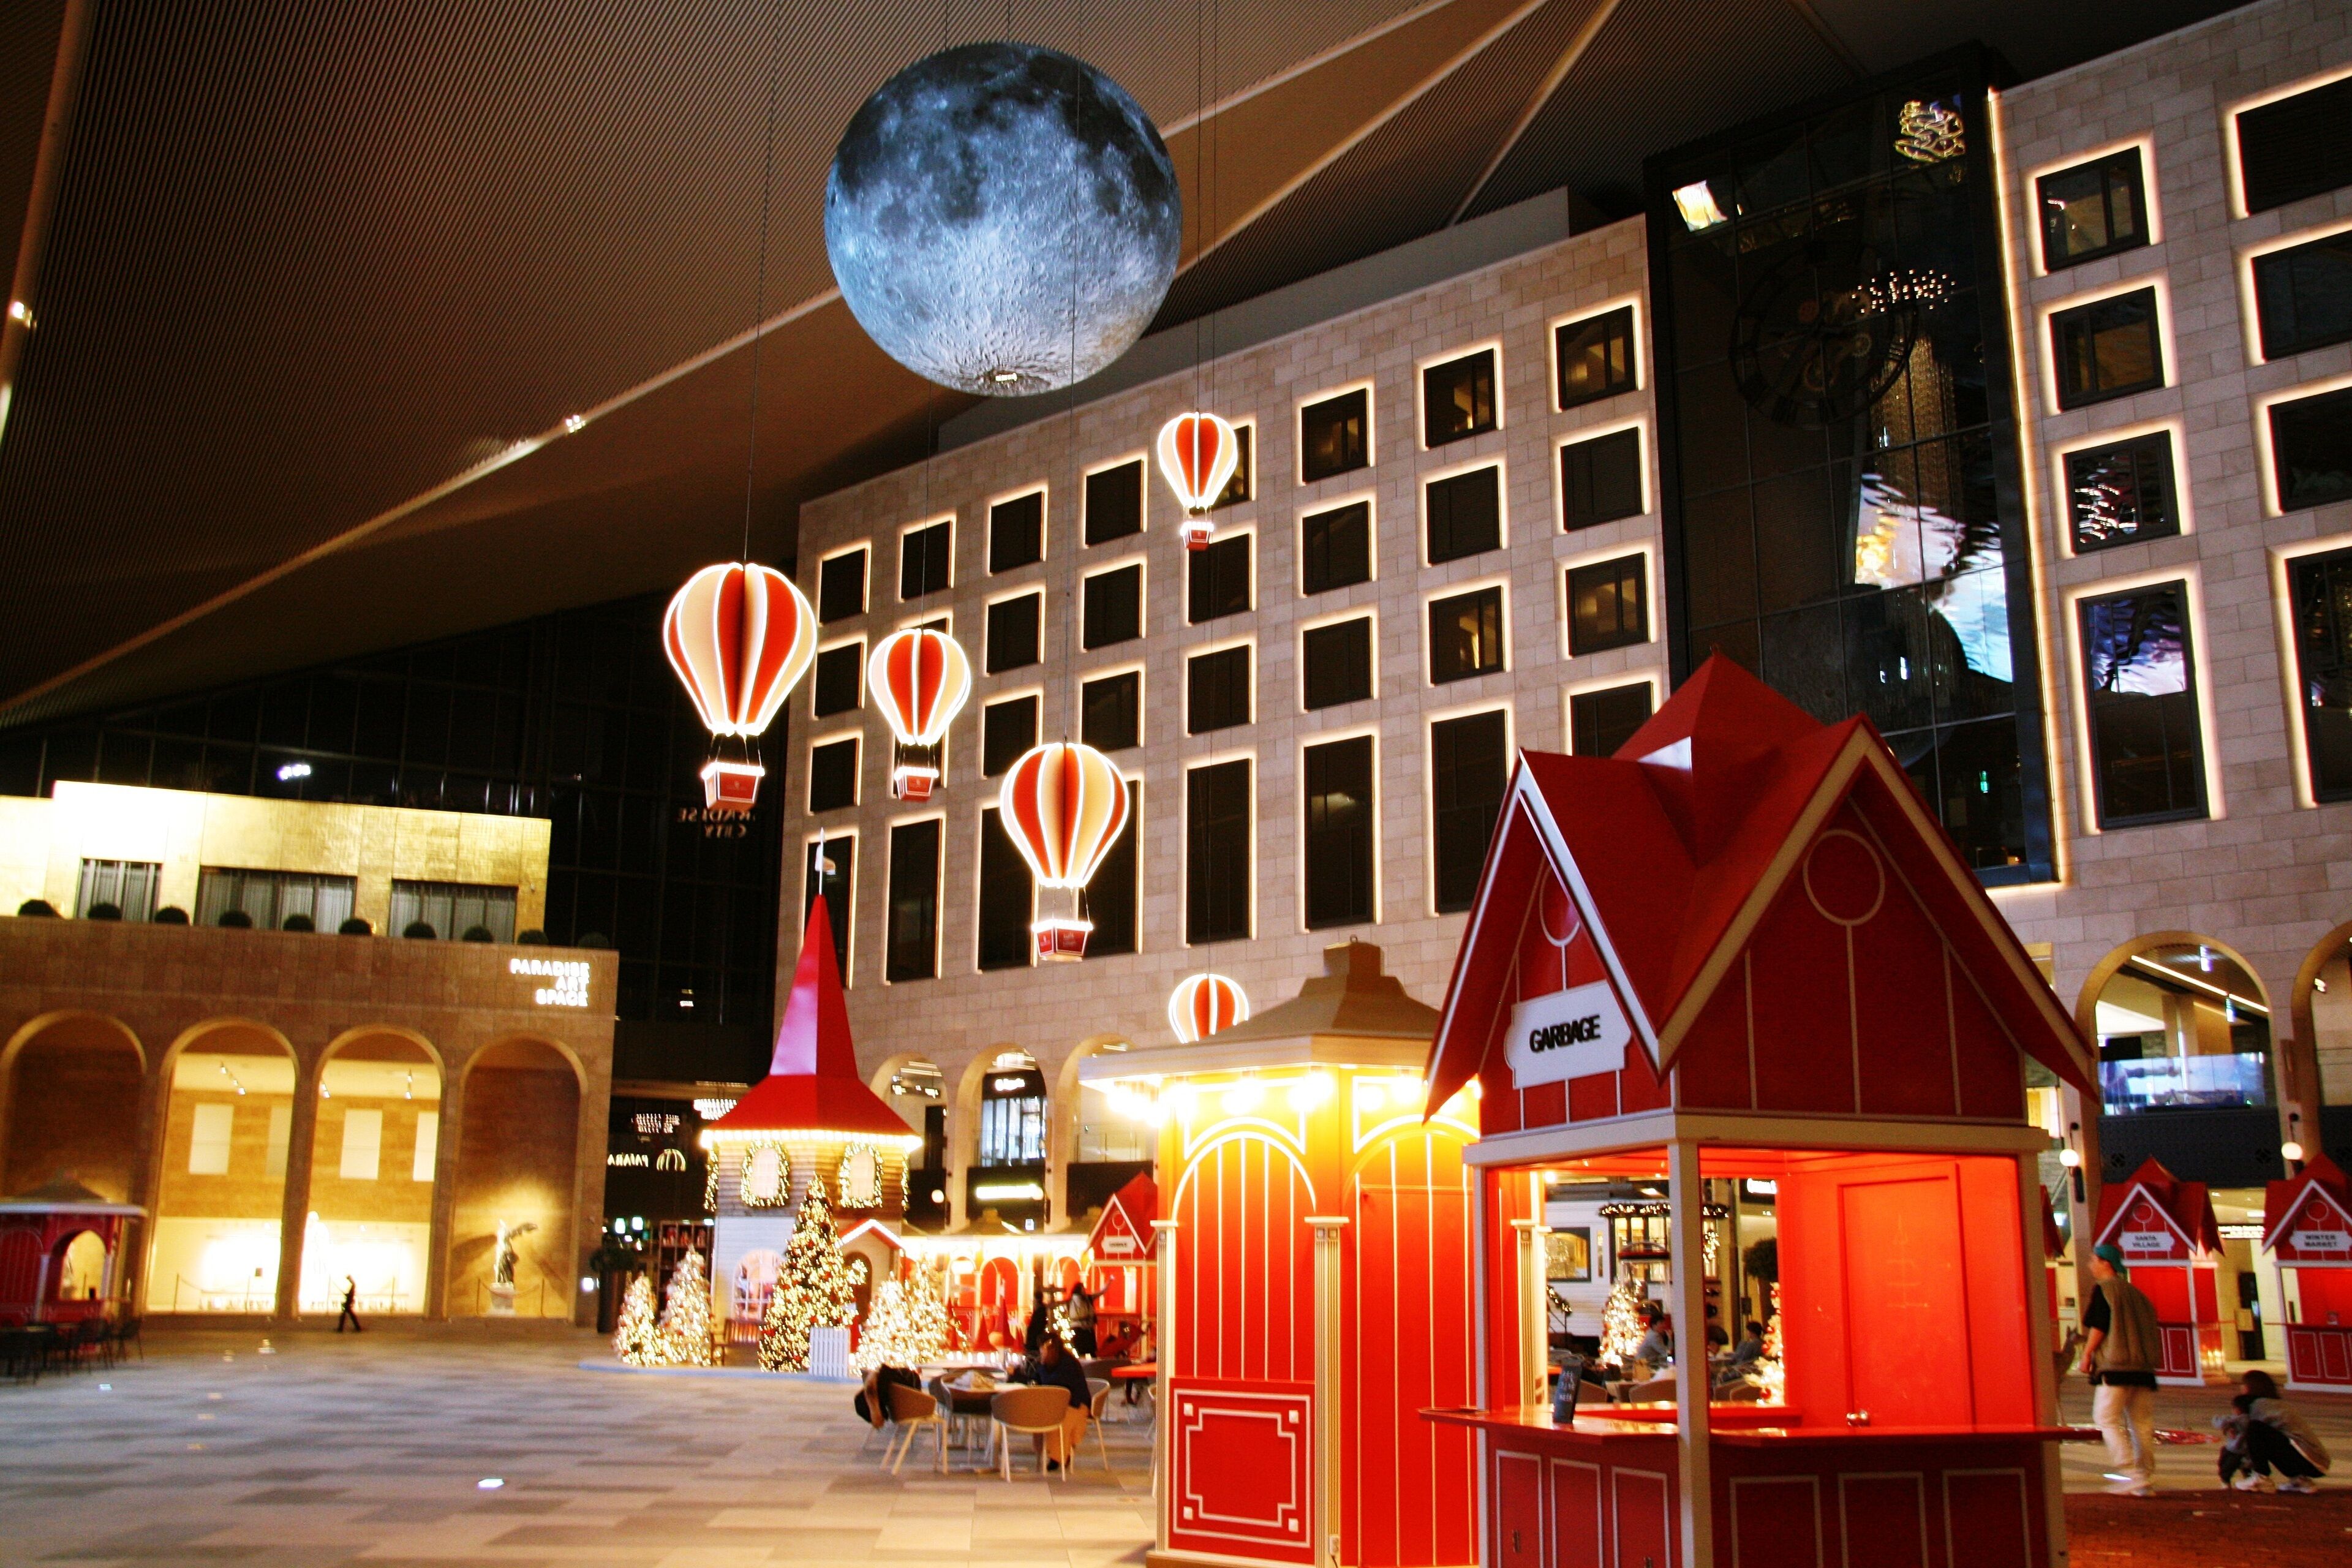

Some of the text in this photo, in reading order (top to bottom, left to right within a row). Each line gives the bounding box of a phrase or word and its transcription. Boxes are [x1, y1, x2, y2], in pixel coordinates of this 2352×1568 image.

[510, 958, 590, 978] PARADISE
[556, 975, 590, 992] ART
[535, 988, 589, 1007] SPACE
[1529, 1014, 1601, 1053] GARBAGE
